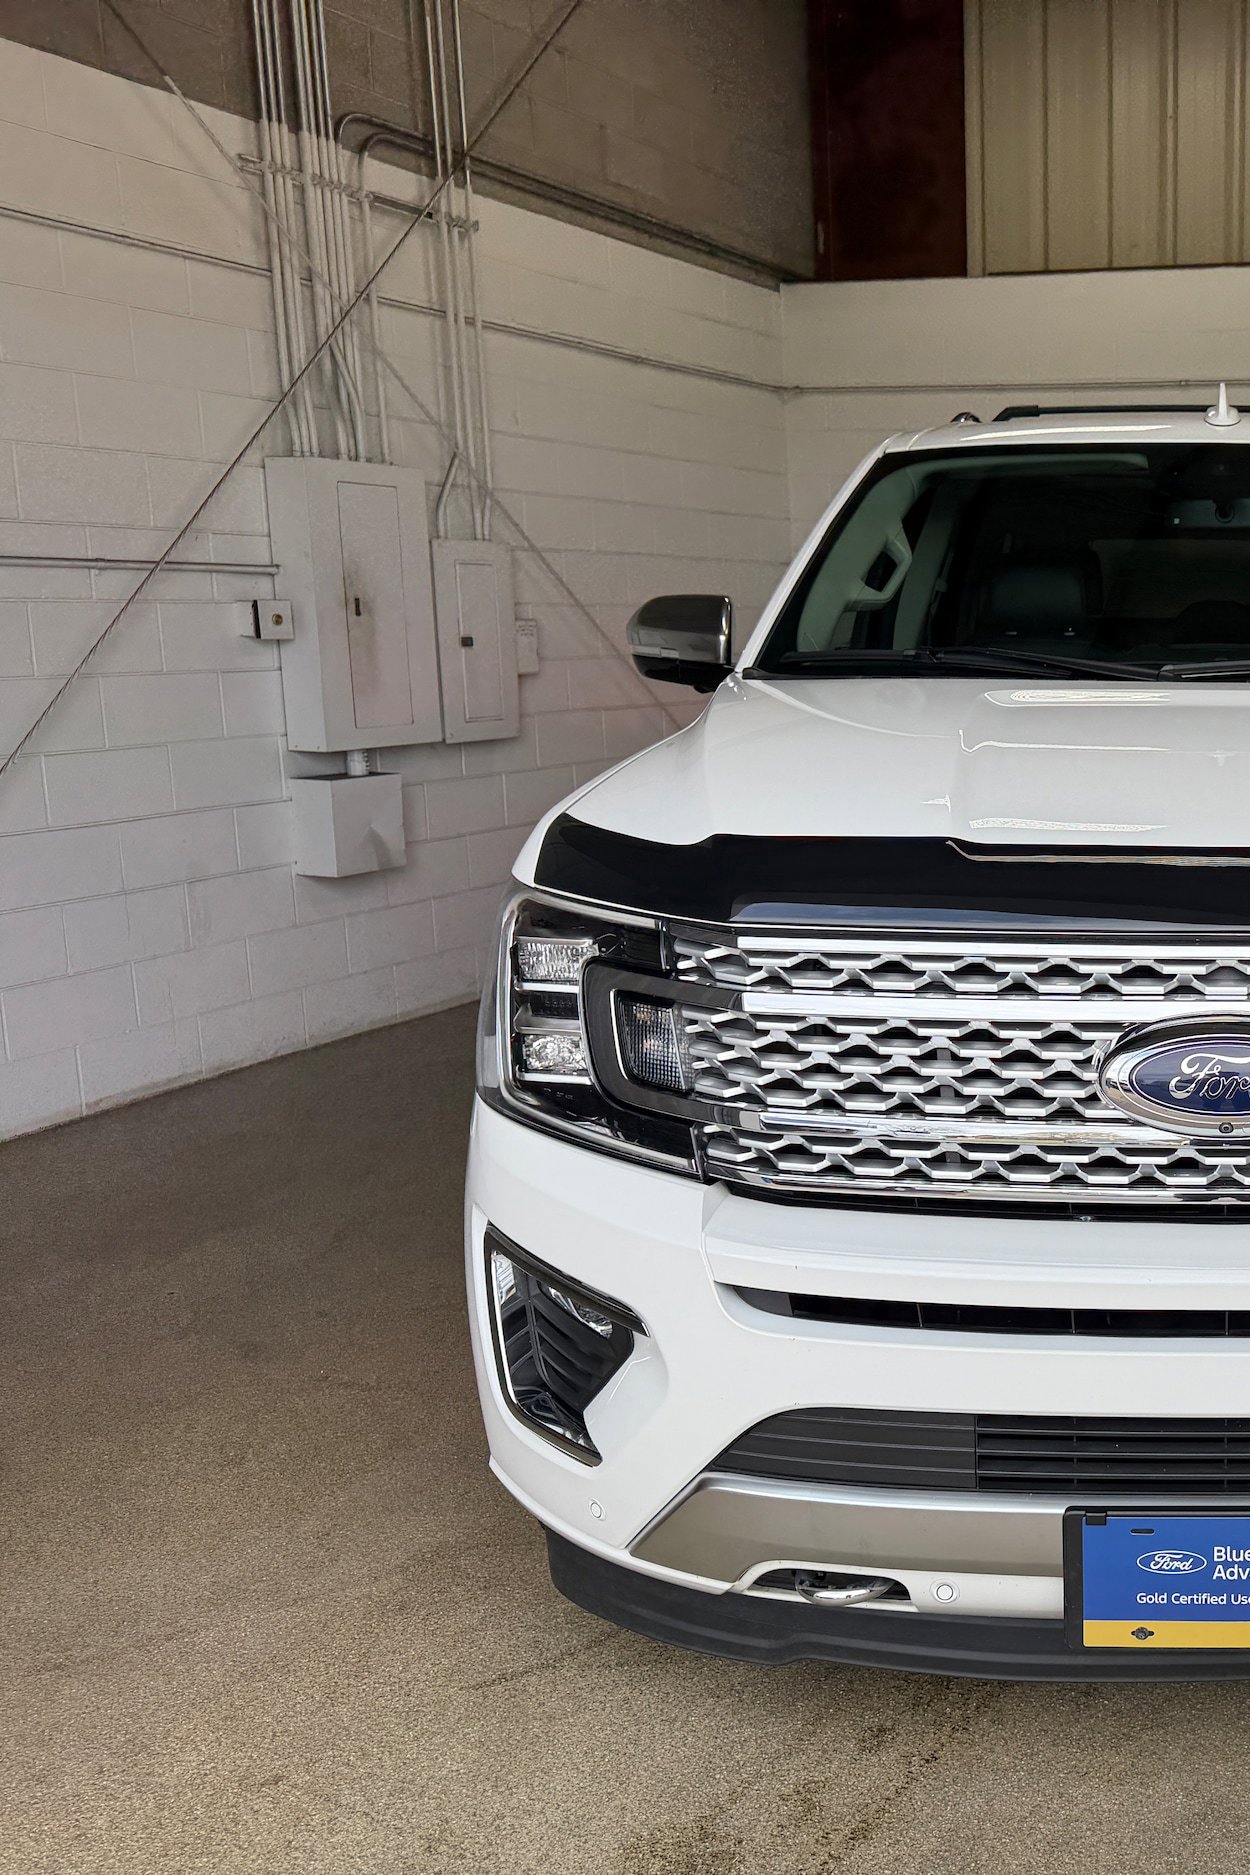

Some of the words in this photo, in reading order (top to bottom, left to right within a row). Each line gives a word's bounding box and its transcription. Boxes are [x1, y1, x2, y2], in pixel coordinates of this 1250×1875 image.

[1150, 1553, 1194, 1571] Ford
[1136, 1592, 1168, 1604] Gold
[1171, 1592, 1227, 1605] Certified
